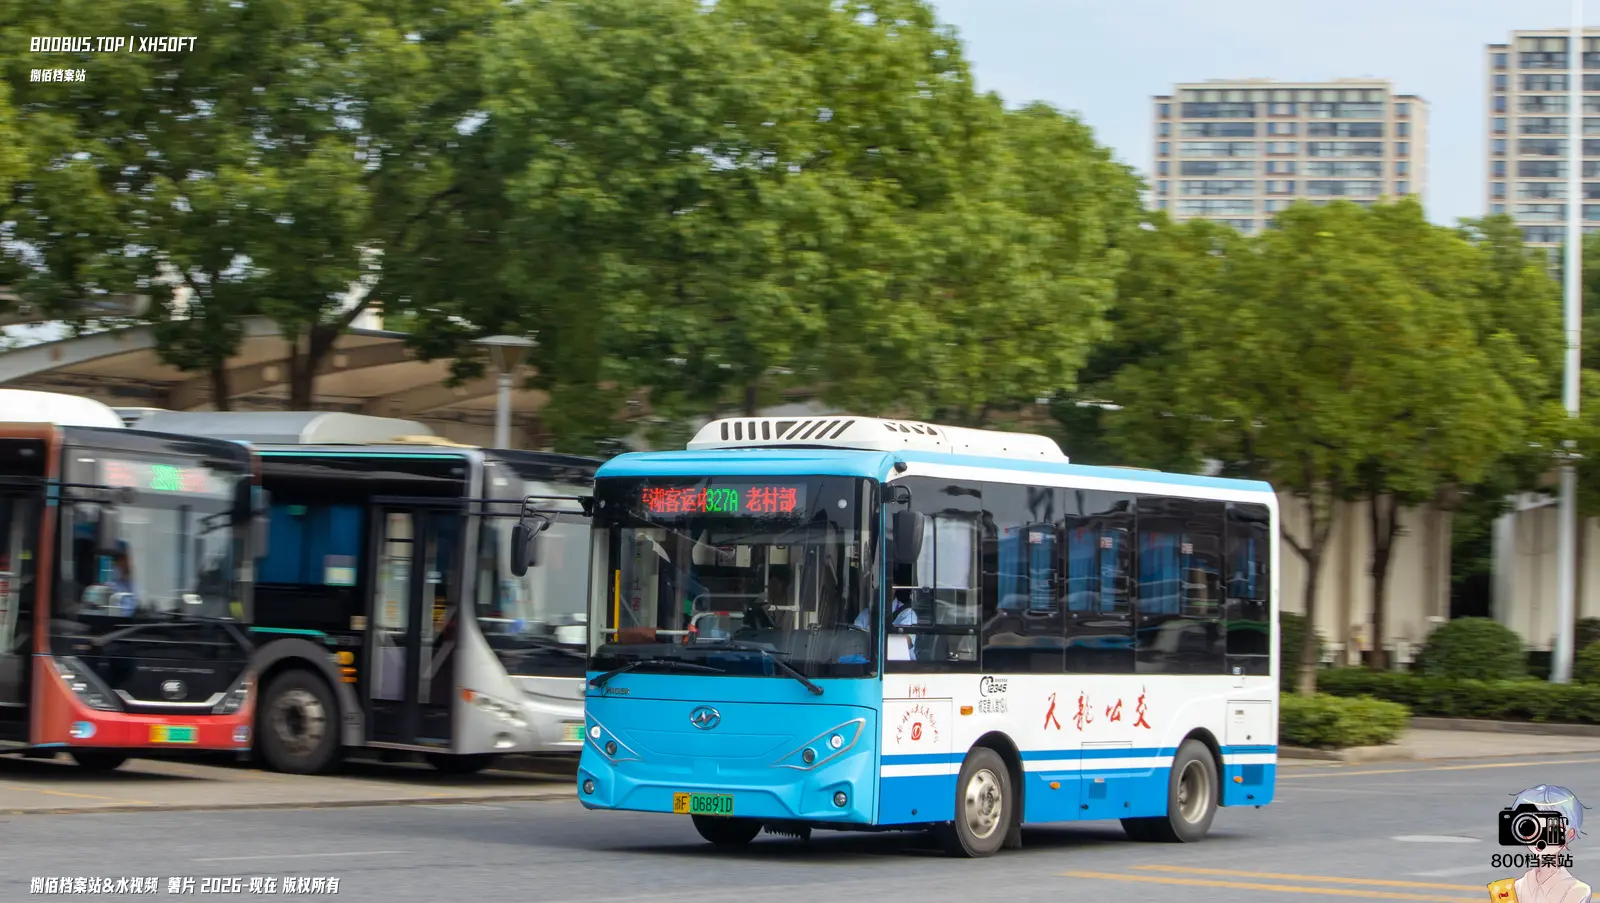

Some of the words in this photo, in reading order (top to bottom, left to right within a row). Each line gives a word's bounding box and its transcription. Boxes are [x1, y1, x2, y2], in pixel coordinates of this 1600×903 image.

[706, 488, 739, 512] 327A
[745, 487, 797, 513] 老村部
